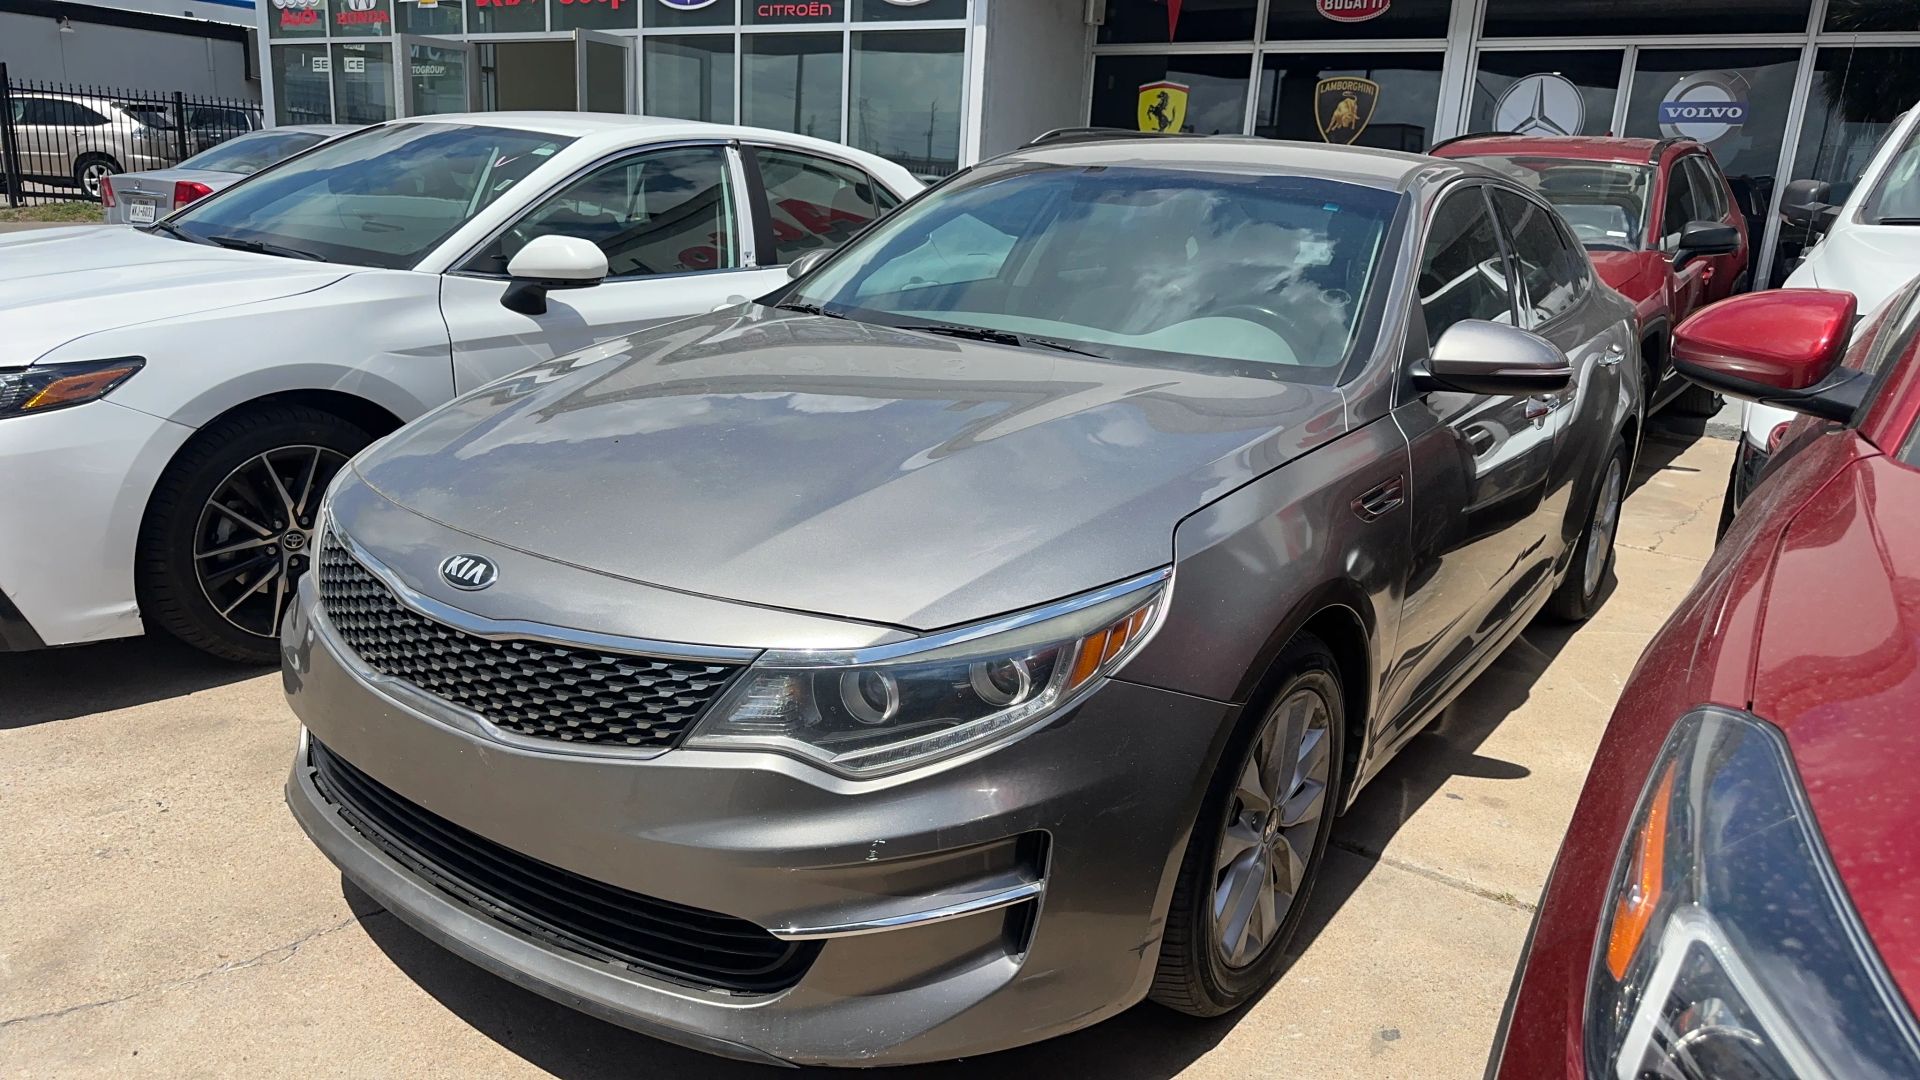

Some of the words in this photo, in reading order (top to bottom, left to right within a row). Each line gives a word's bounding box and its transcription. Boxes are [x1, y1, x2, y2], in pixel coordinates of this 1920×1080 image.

[335, 10, 390, 25] HONDA
[1320, 81, 1375, 95] LAMBORGHINI
[1665, 107, 1743, 118] VOLVO
[444, 555, 487, 584] KIA
